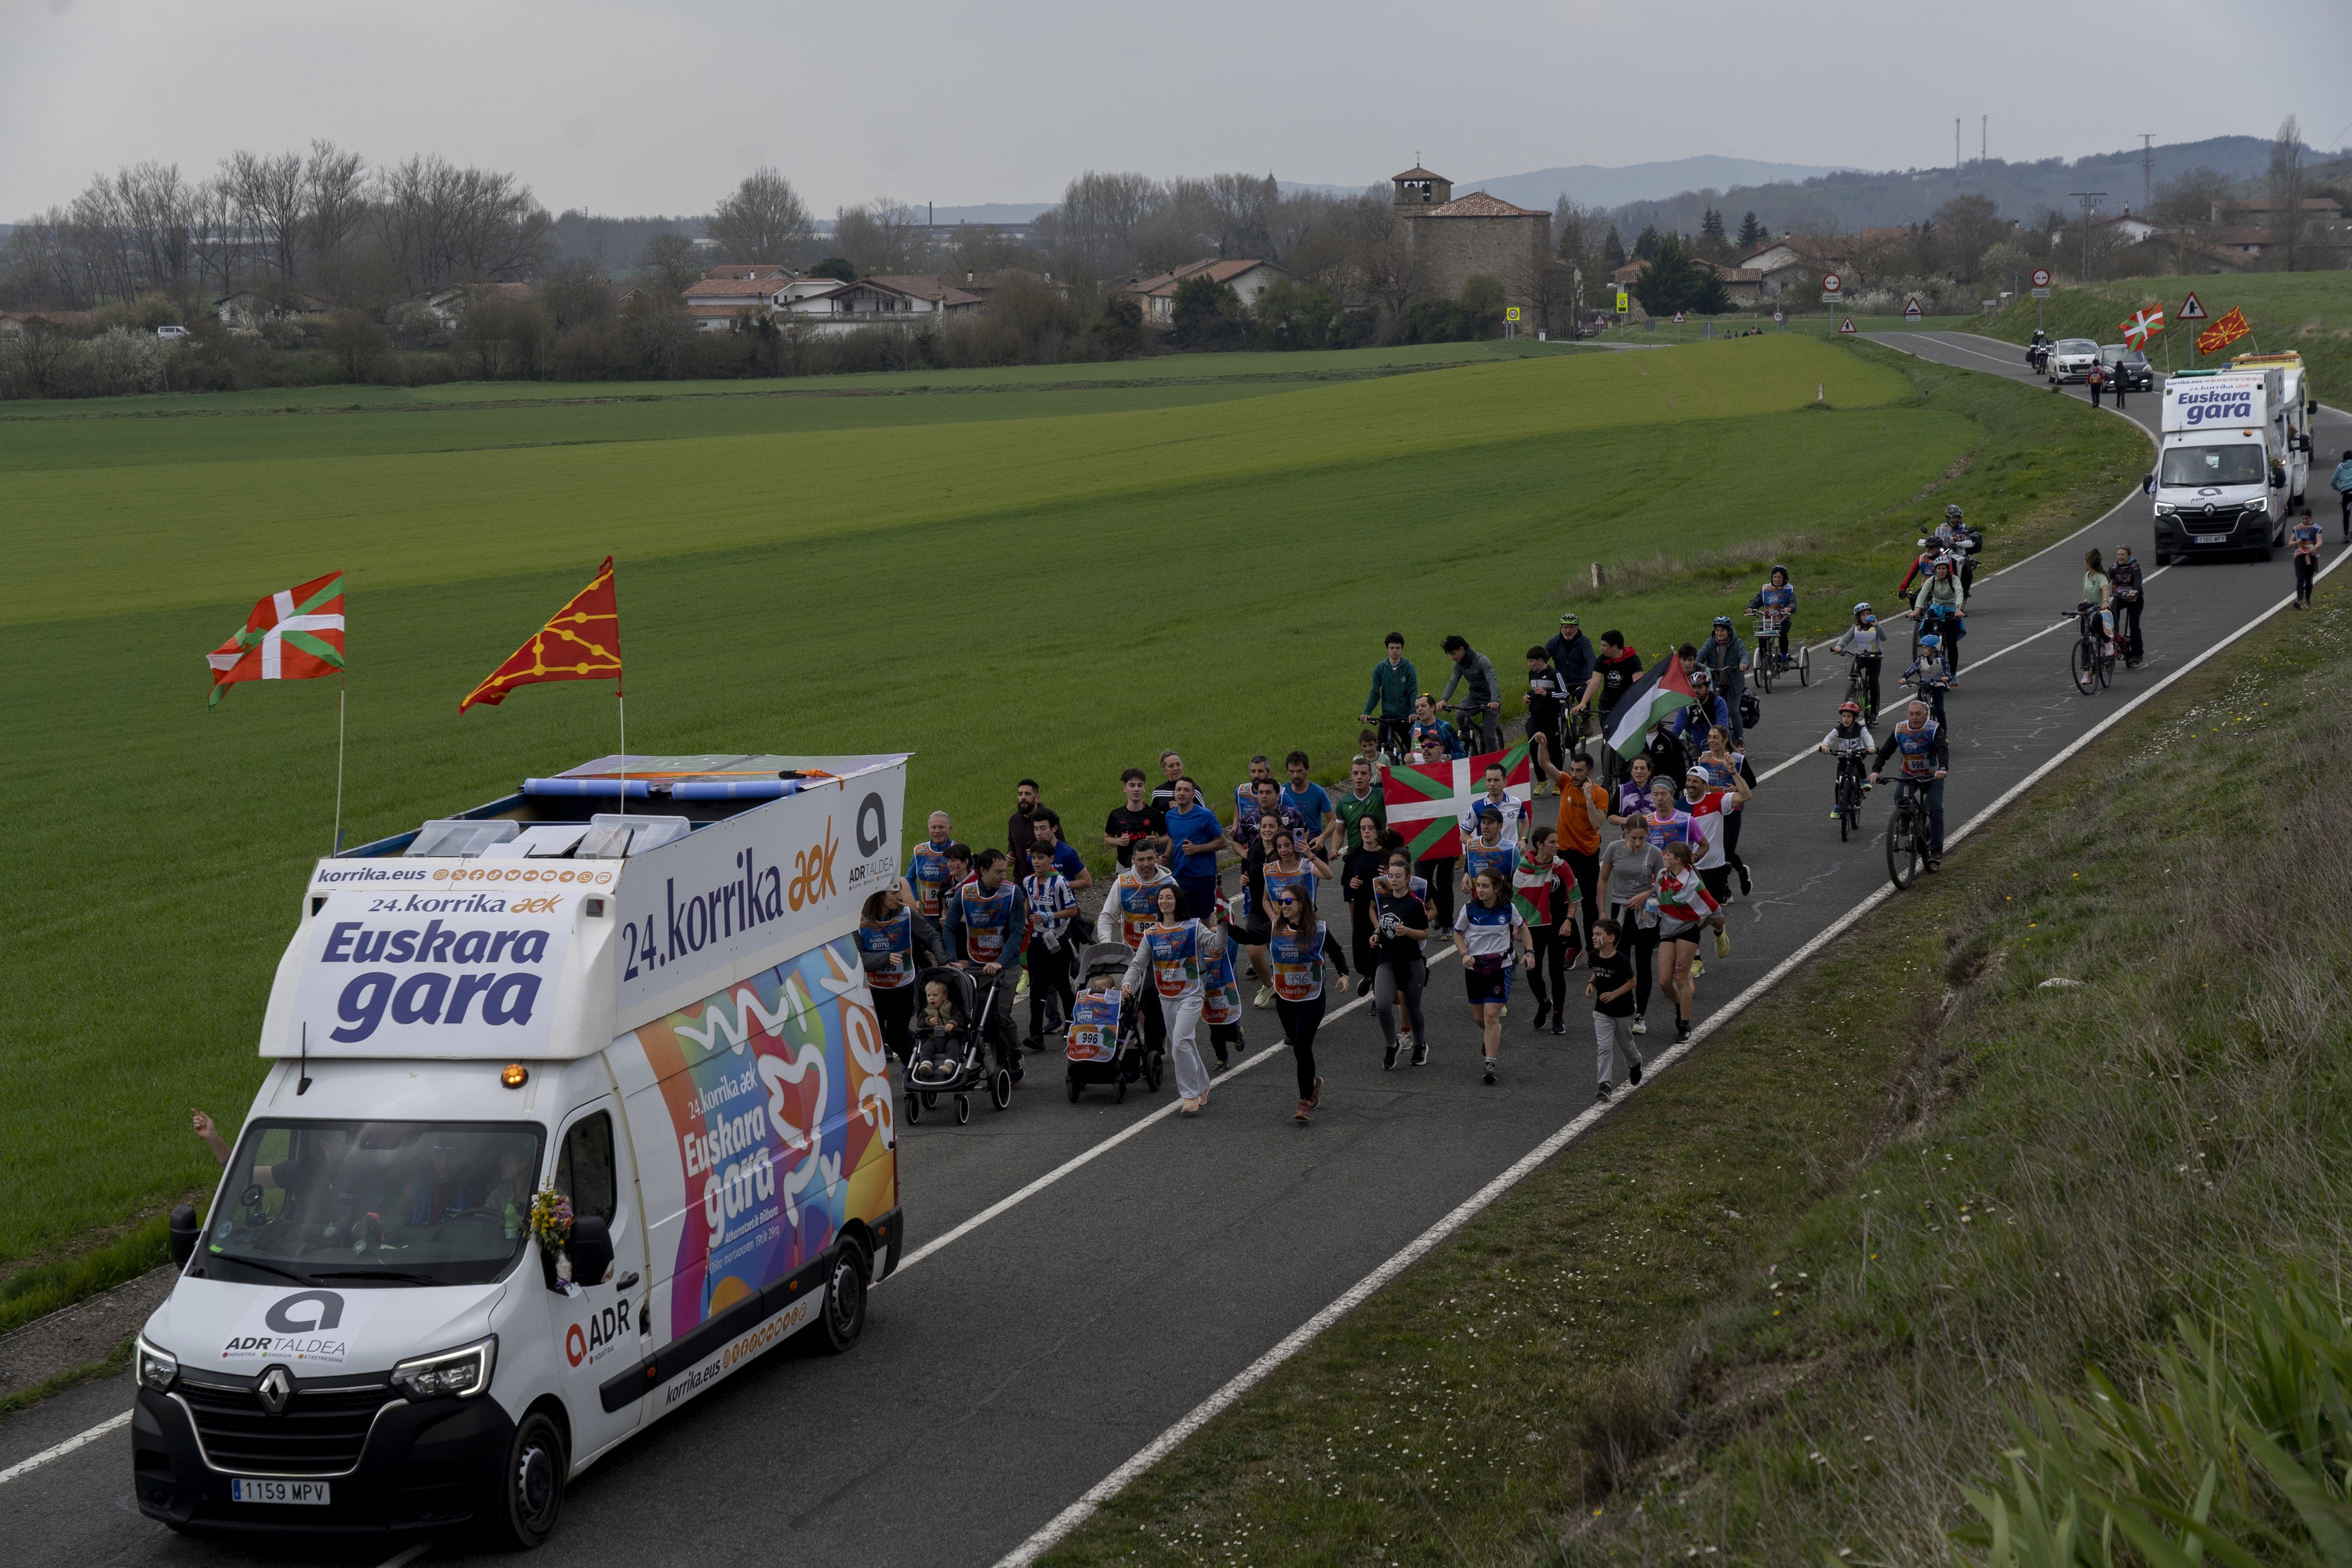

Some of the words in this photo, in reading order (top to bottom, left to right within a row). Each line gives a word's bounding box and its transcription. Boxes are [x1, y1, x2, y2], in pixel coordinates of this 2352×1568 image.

[2178, 390, 2250, 405] Euskara
[2187, 403, 2252, 425] gara
[1911, 760, 1924, 769] 996
[317, 867, 426, 884] korrika.eus
[368, 894, 506, 913] 24.korrika
[510, 894, 564, 914] aek
[622, 846, 784, 982] 24.korrika
[788, 814, 839, 912] aek
[321, 919, 550, 964] Euskara
[981, 936, 999, 947] 996
[1165, 970, 1178, 980] 996
[1287, 974, 1308, 985] 996
[328, 971, 543, 1044] gara
[1212, 997, 1226, 1010] 996
[1082, 1033, 1098, 1044] 996
[1069, 1047, 1094, 1055] 24.korrika
[688, 1074, 740, 1120] 24.korrika
[740, 1061, 758, 1094] aek
[684, 1105, 766, 1178] Euskara
[703, 1146, 775, 1248] gara
[759, 1206, 779, 1225] Bilbora
[723, 1240, 754, 1265] martxoaren
[768, 1225, 780, 1240] 29ra
[590, 1298, 631, 1353] ADR
[304, 1355, 343, 1363] ETXETRESNAK
[666, 1359, 721, 1406] korrika.eus
[246, 1482, 285, 1501] 1159
[292, 1484, 323, 1501] MPV
